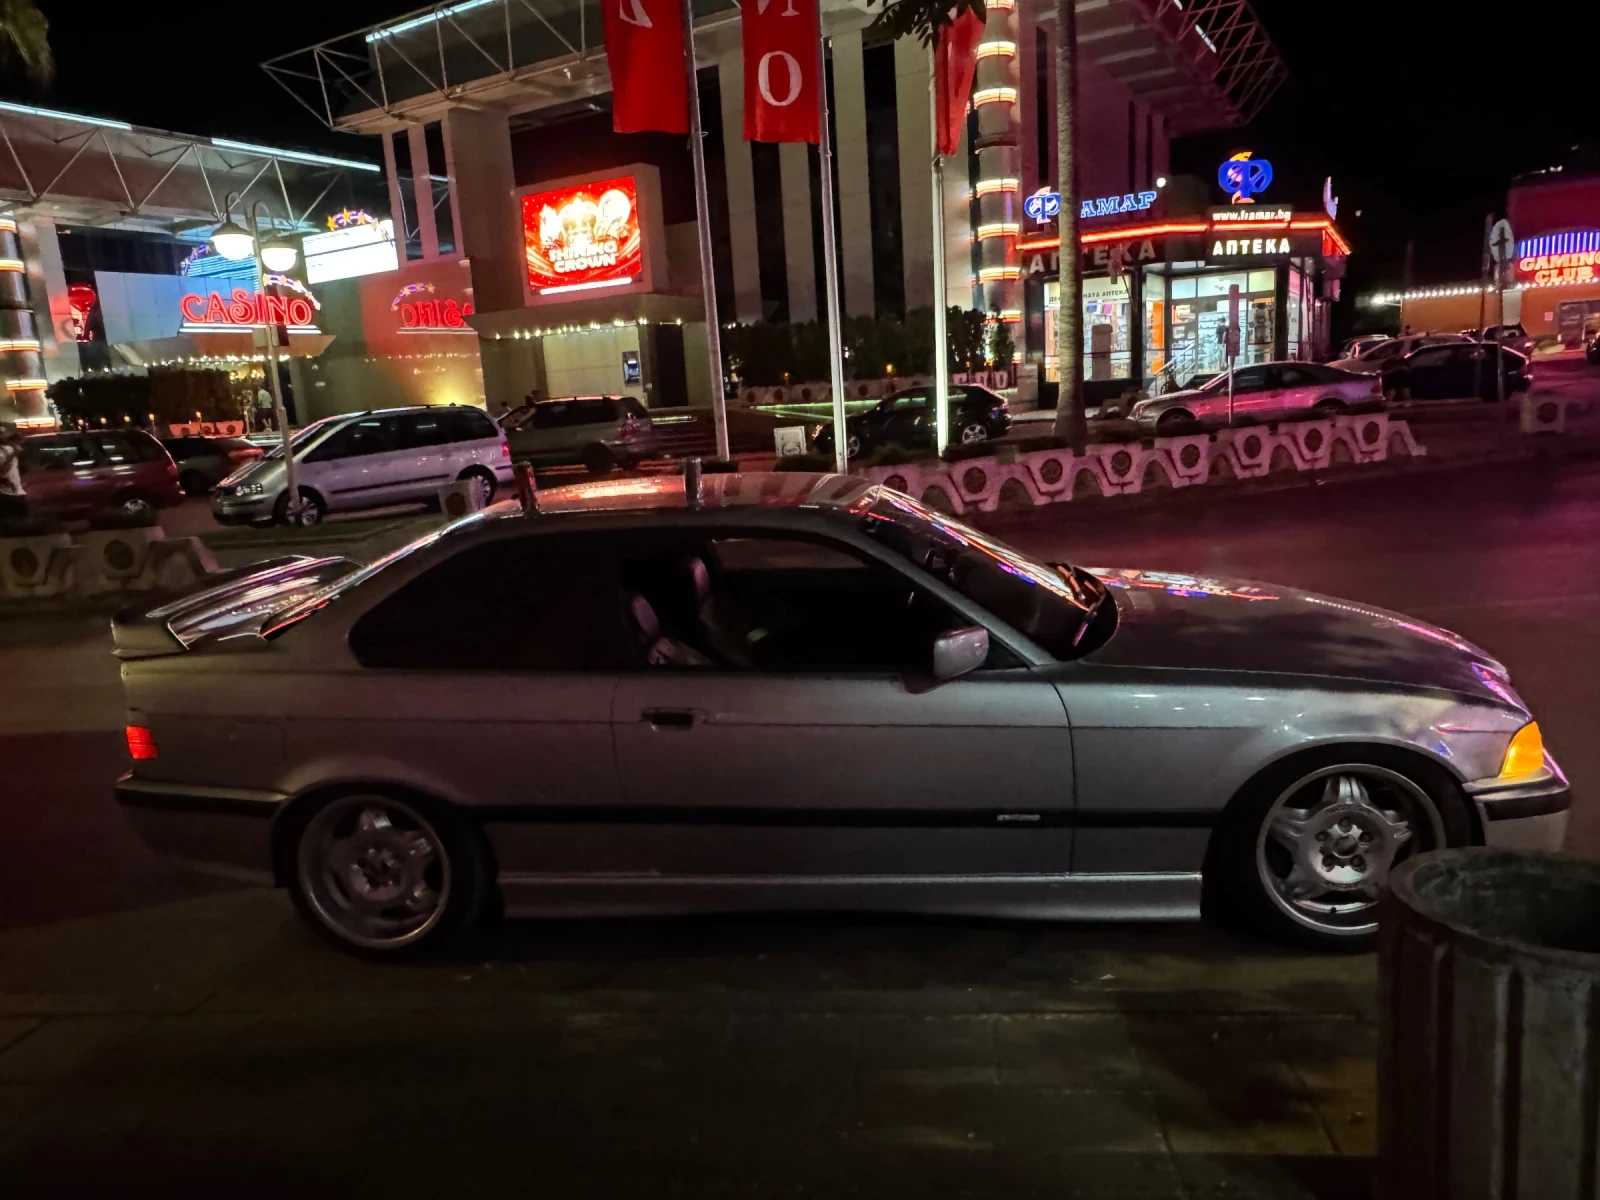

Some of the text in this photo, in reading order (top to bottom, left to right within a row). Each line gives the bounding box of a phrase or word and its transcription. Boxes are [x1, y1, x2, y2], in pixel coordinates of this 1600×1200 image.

[1024, 186, 1157, 224] ФАМАР
[1212, 209, 1291, 222] www.framar.bg
[1212, 238, 1290, 256] АПТЕКА
[554, 253, 617, 273] CROWN
[1535, 266, 1593, 283] CLUB
[180, 288, 312, 325] CASINO
